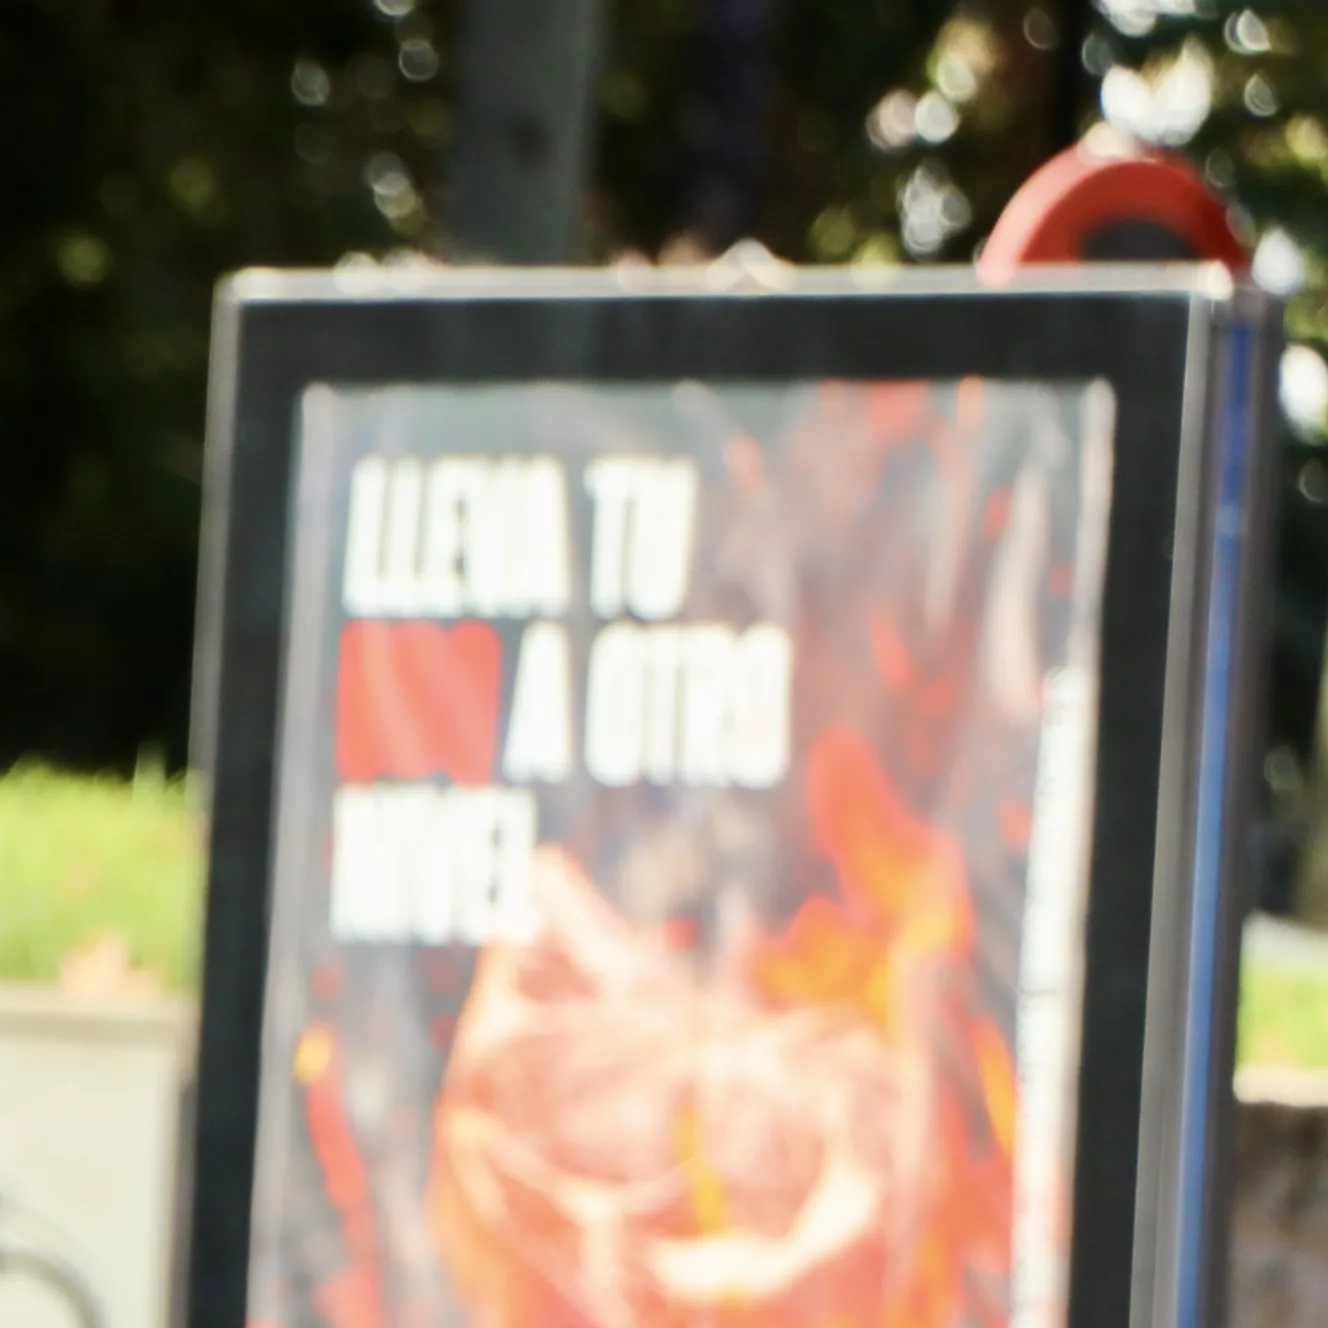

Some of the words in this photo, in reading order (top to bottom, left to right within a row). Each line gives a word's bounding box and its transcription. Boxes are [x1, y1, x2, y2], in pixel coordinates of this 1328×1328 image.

[342, 454, 572, 618] LLEVA
[585, 454, 700, 621] TU
[502, 620, 573, 783] A
[585, 620, 795, 789] OTRO
